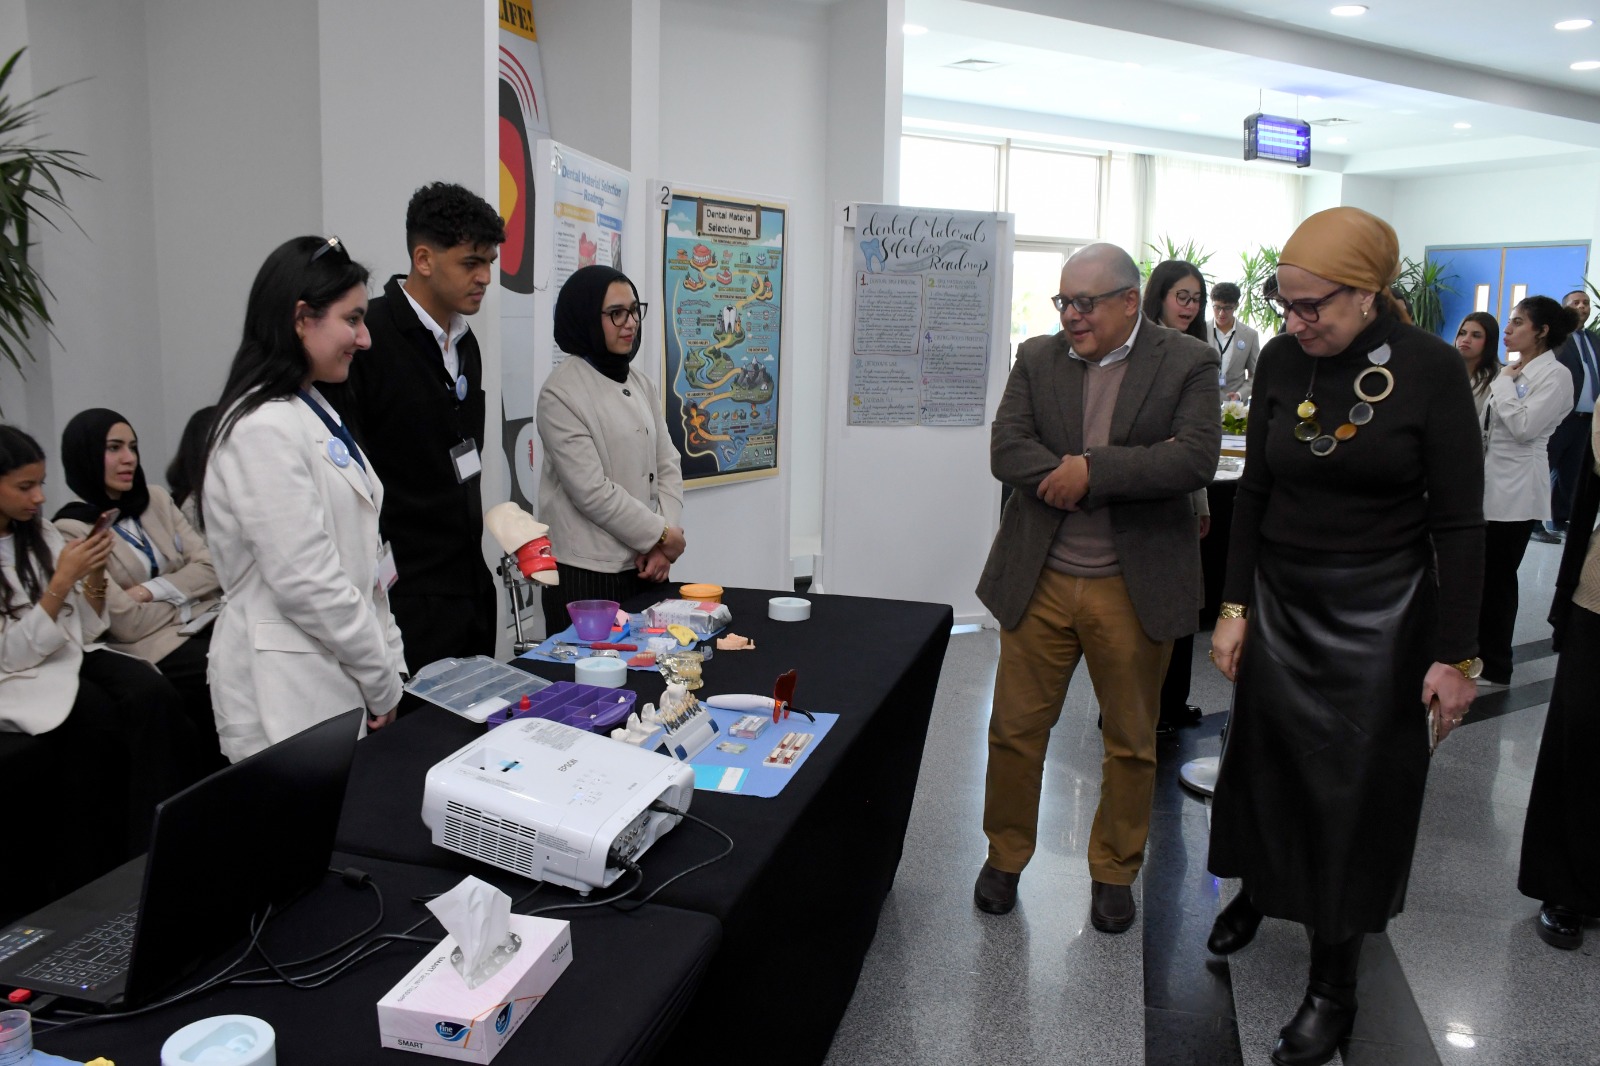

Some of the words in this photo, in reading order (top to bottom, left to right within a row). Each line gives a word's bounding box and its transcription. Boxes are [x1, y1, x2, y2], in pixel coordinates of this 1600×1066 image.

[562, 165, 580, 183] Dental
[582, 172, 600, 189] Material
[601, 180, 621, 198] Selection
[584, 189, 604, 210] Roadmap
[661, 186, 670, 205] 2
[706, 209, 727, 219] Dental
[728, 212, 752, 222] Material
[844, 206, 850, 222] 1
[708, 223, 737, 234] Selection
[738, 226, 751, 237] Map
[881, 236, 941, 263] Selection
[930, 250, 988, 277] Roadmap
[558, 759, 578, 772] EPSON
[427, 957, 445, 972] SMART
[439, 1022, 453, 1033] fine
[398, 1038, 423, 1049] SMART
